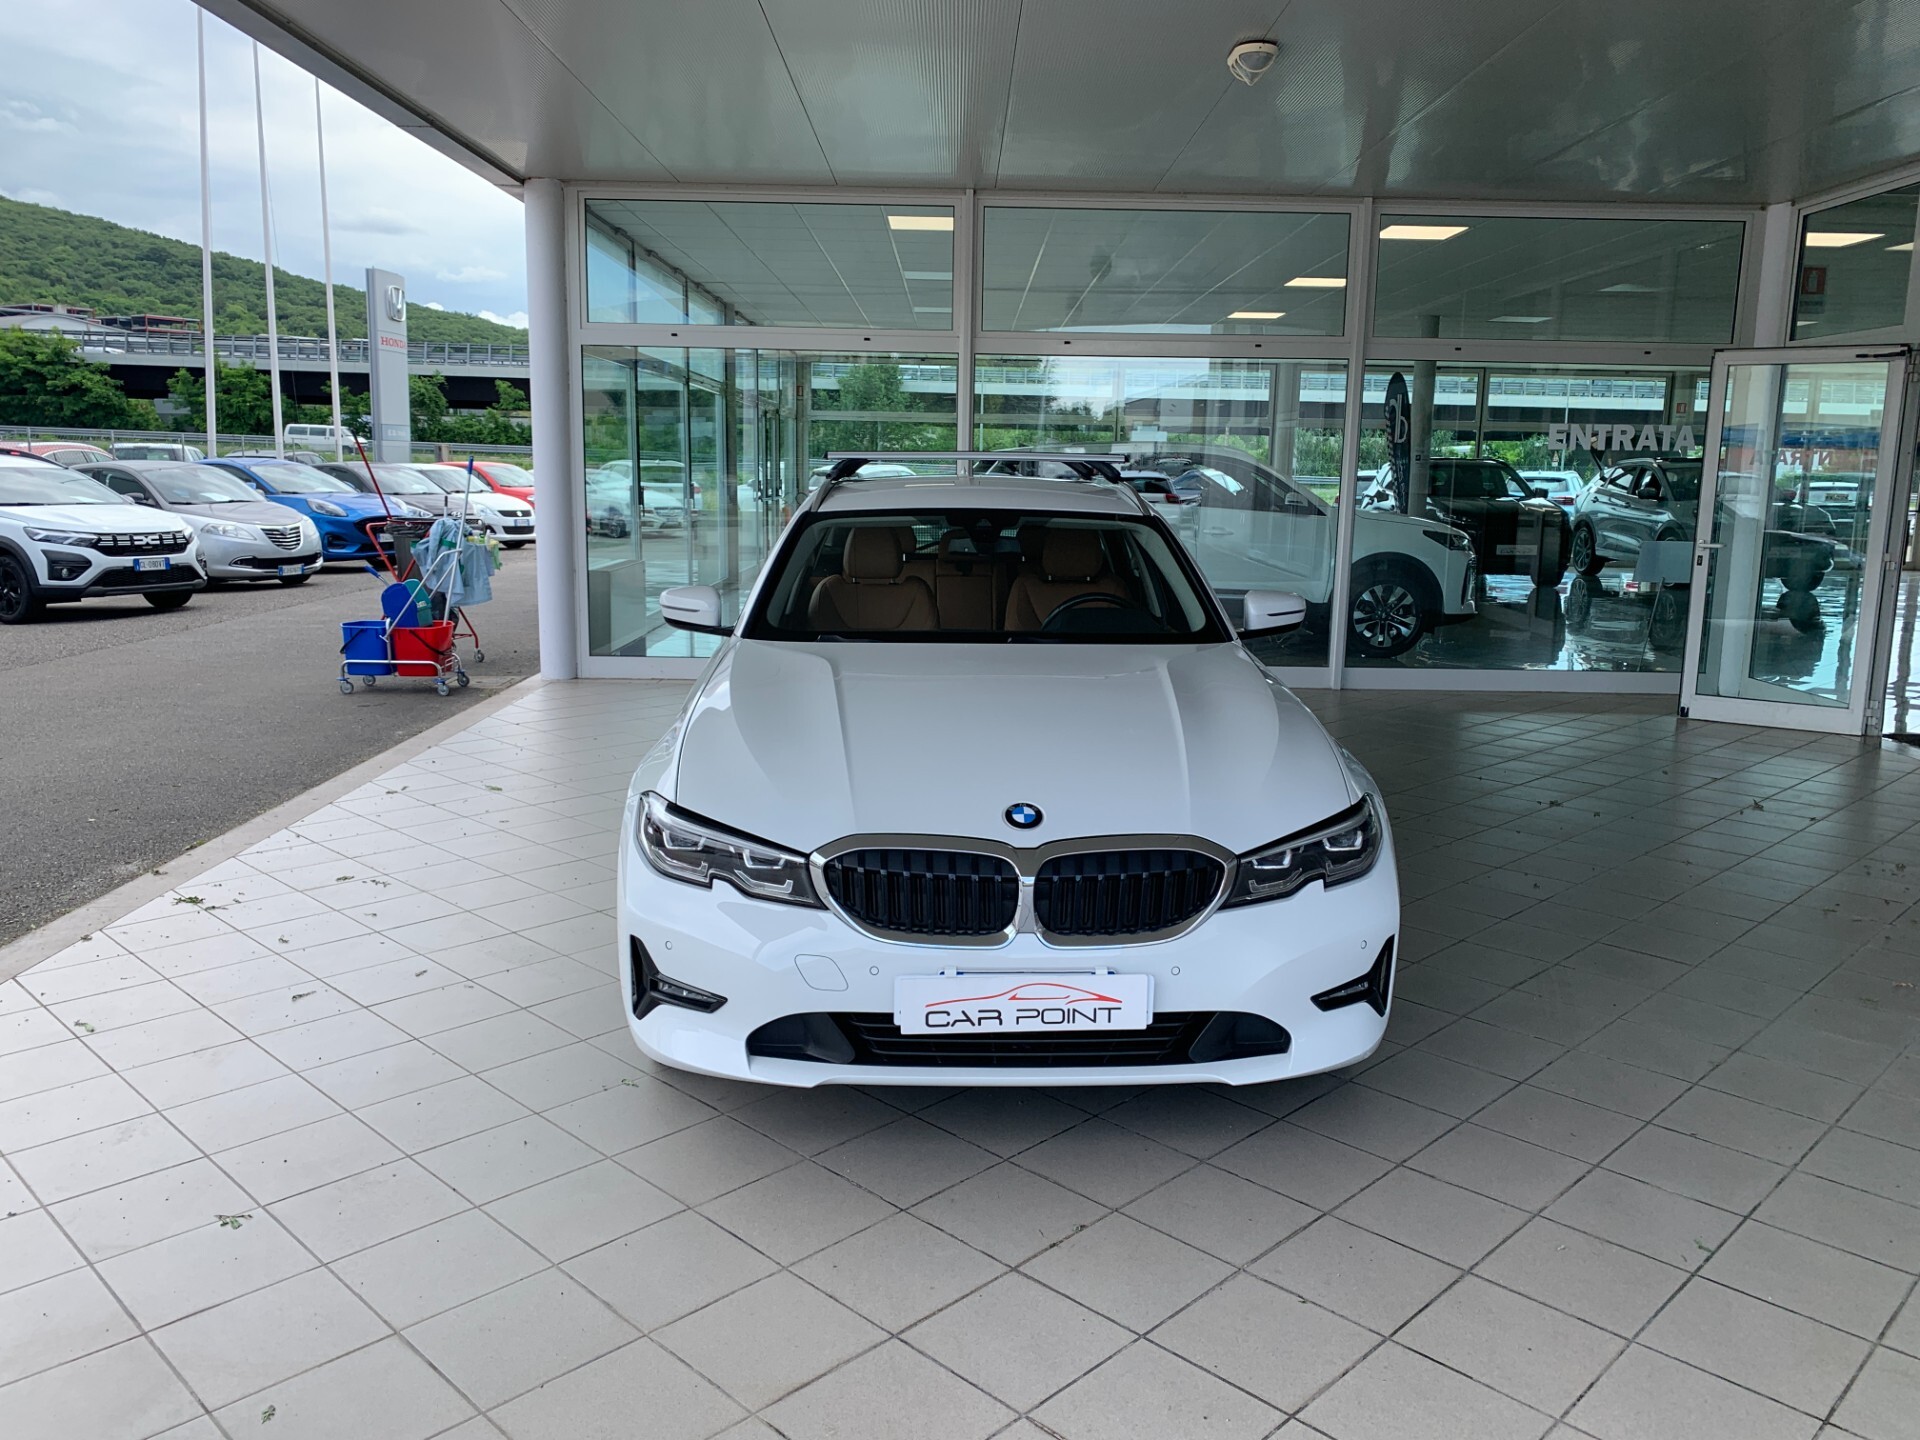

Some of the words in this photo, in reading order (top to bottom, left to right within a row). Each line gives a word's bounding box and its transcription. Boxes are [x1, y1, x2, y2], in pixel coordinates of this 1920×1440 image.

[1548, 423, 1696, 451] ENTRATA
[925, 1010, 1003, 1028] CAR
[1015, 1007, 1122, 1026] POINT
